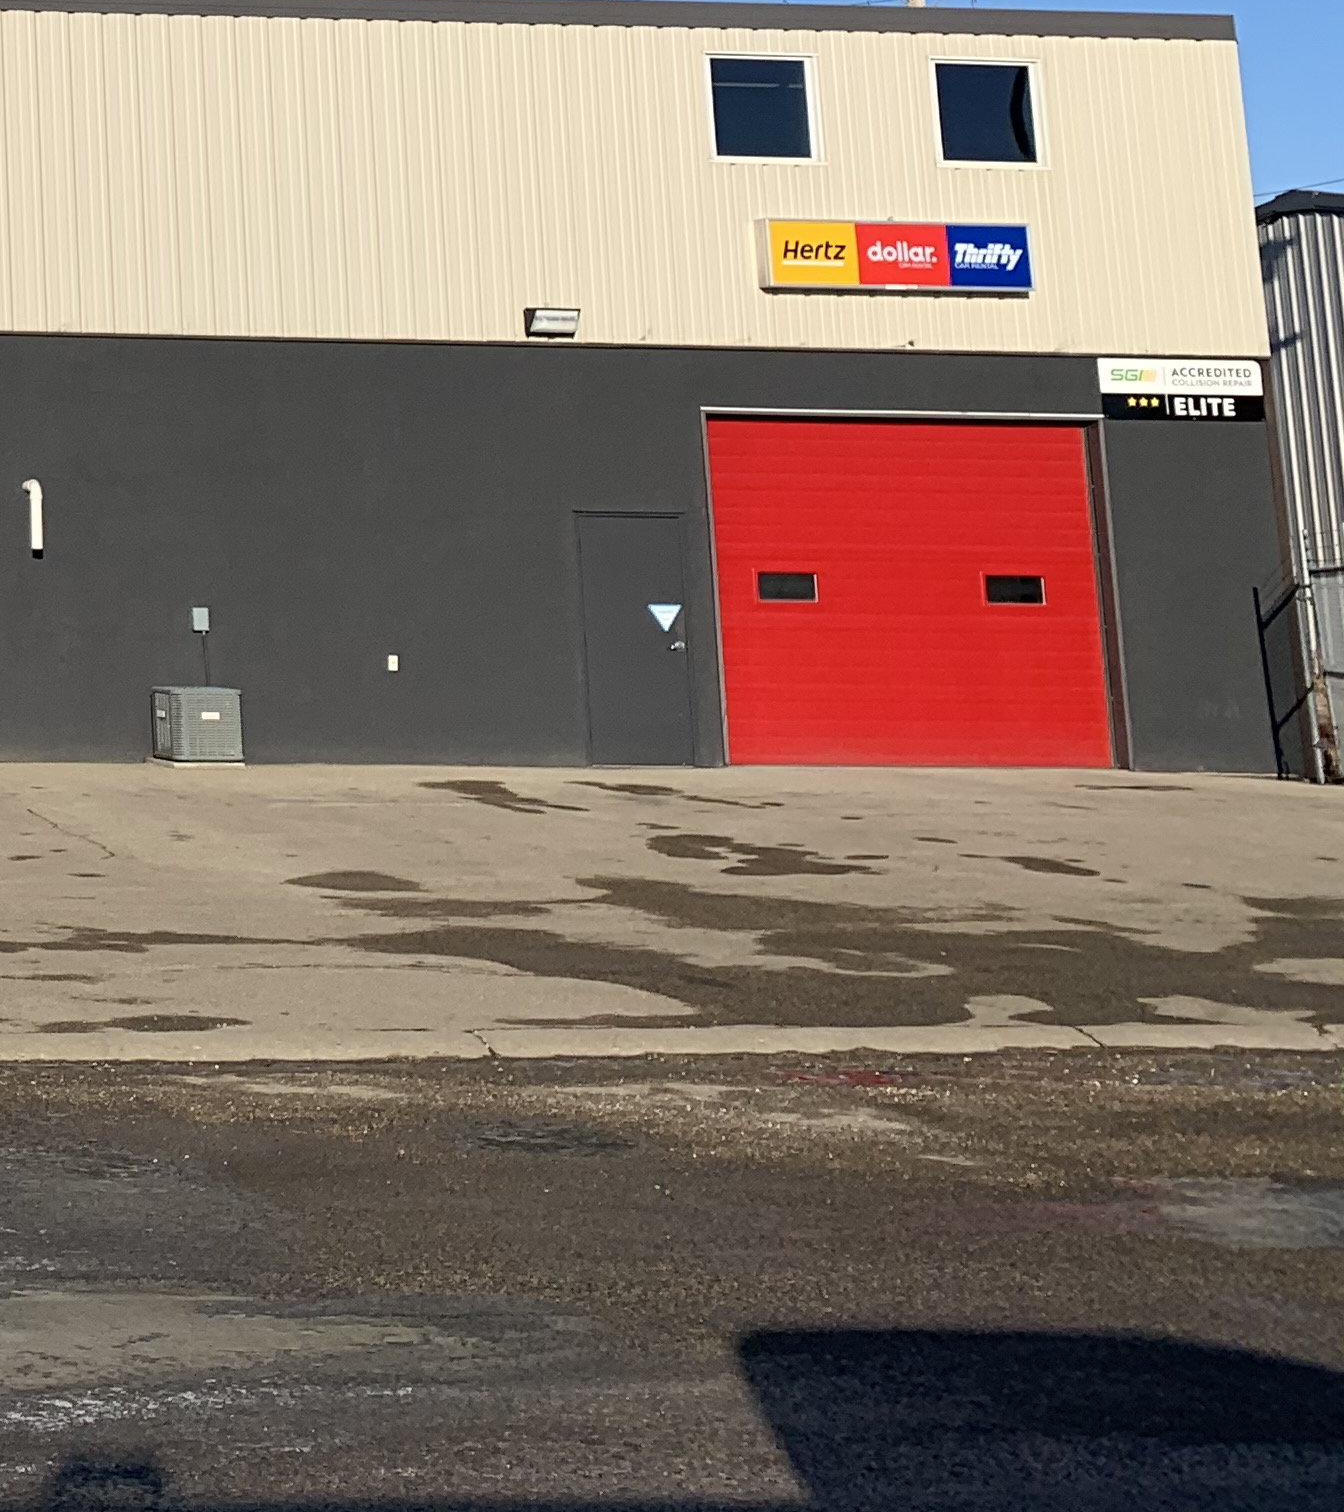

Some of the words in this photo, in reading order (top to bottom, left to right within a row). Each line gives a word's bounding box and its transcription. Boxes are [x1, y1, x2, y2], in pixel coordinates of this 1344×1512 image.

[782, 239, 846, 261] Hertz
[954, 242, 1023, 271] Thrifty
[1111, 368, 1144, 382] SGI
[1171, 367, 1252, 378] ACCREDITED
[1171, 378, 1220, 386] COLLISION
[1222, 379, 1252, 387] REPAIR
[1173, 396, 1237, 417] ELITE
